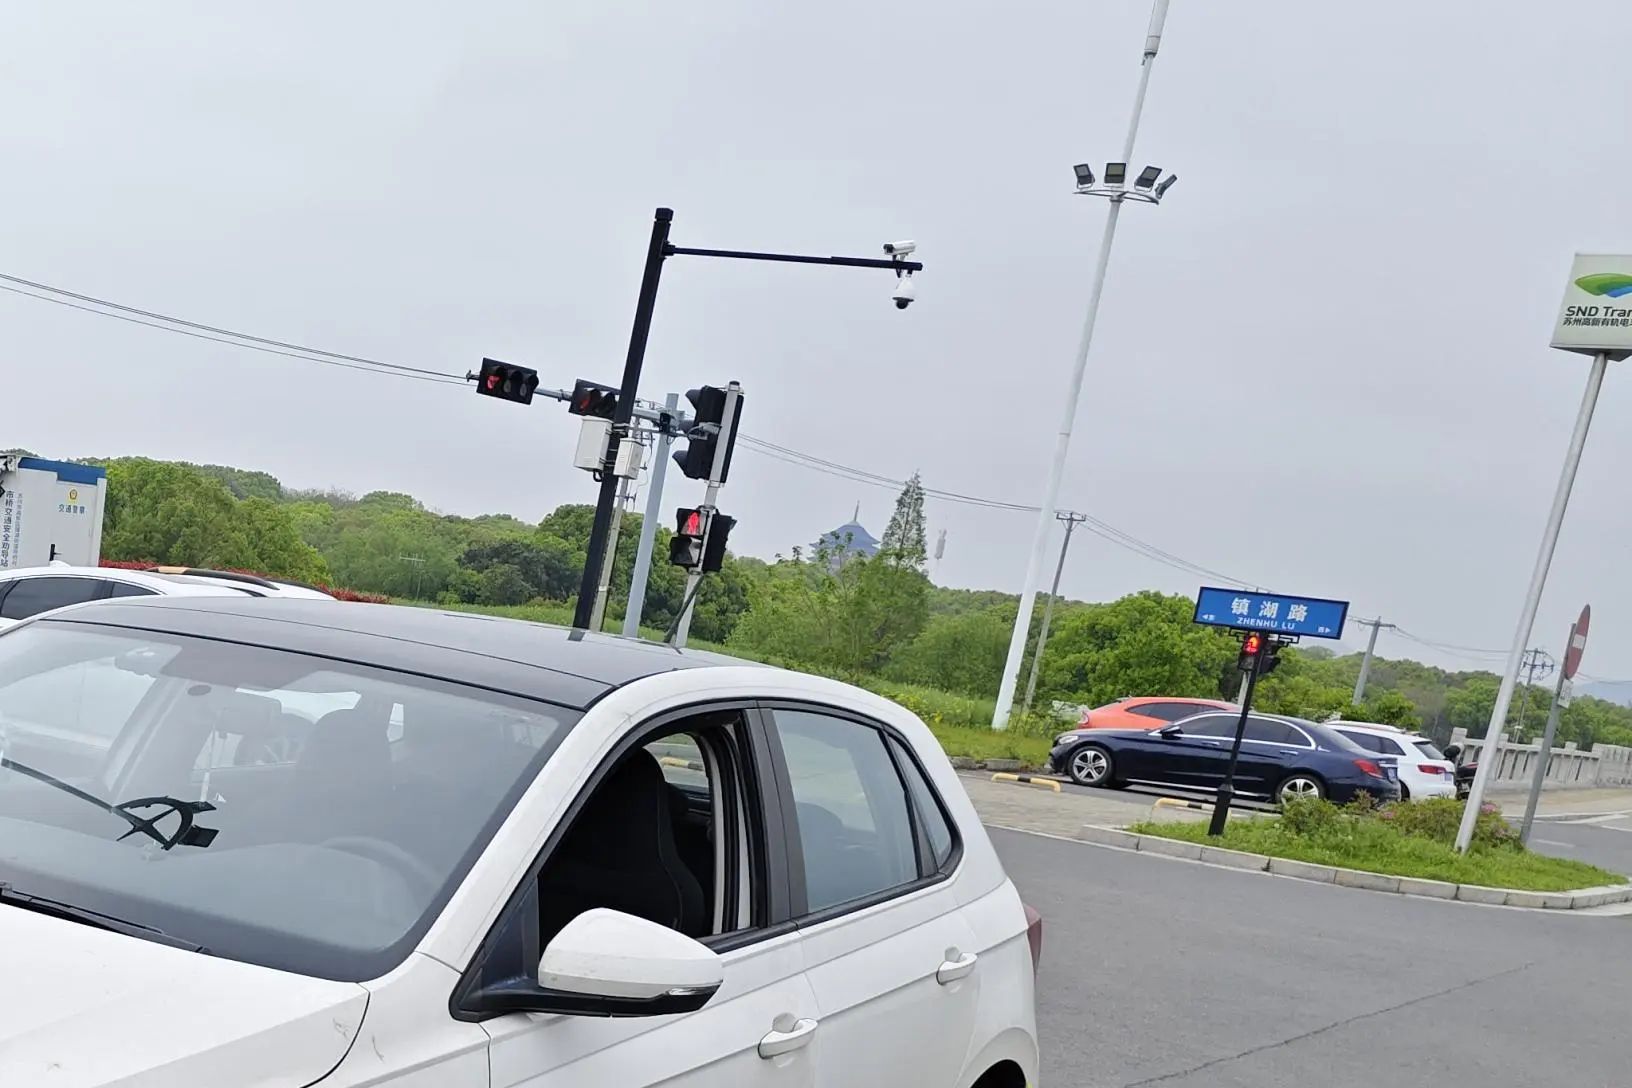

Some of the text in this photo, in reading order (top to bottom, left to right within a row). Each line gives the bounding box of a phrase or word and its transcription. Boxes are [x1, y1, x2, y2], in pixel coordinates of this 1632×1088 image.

[1565, 305, 1599, 317] SND
[1563, 317, 1632, 328] 苏州高新有轨电
[1231, 597, 1308, 622] 镇湖路
[1236, 616, 1296, 631] ZHENHU LU
